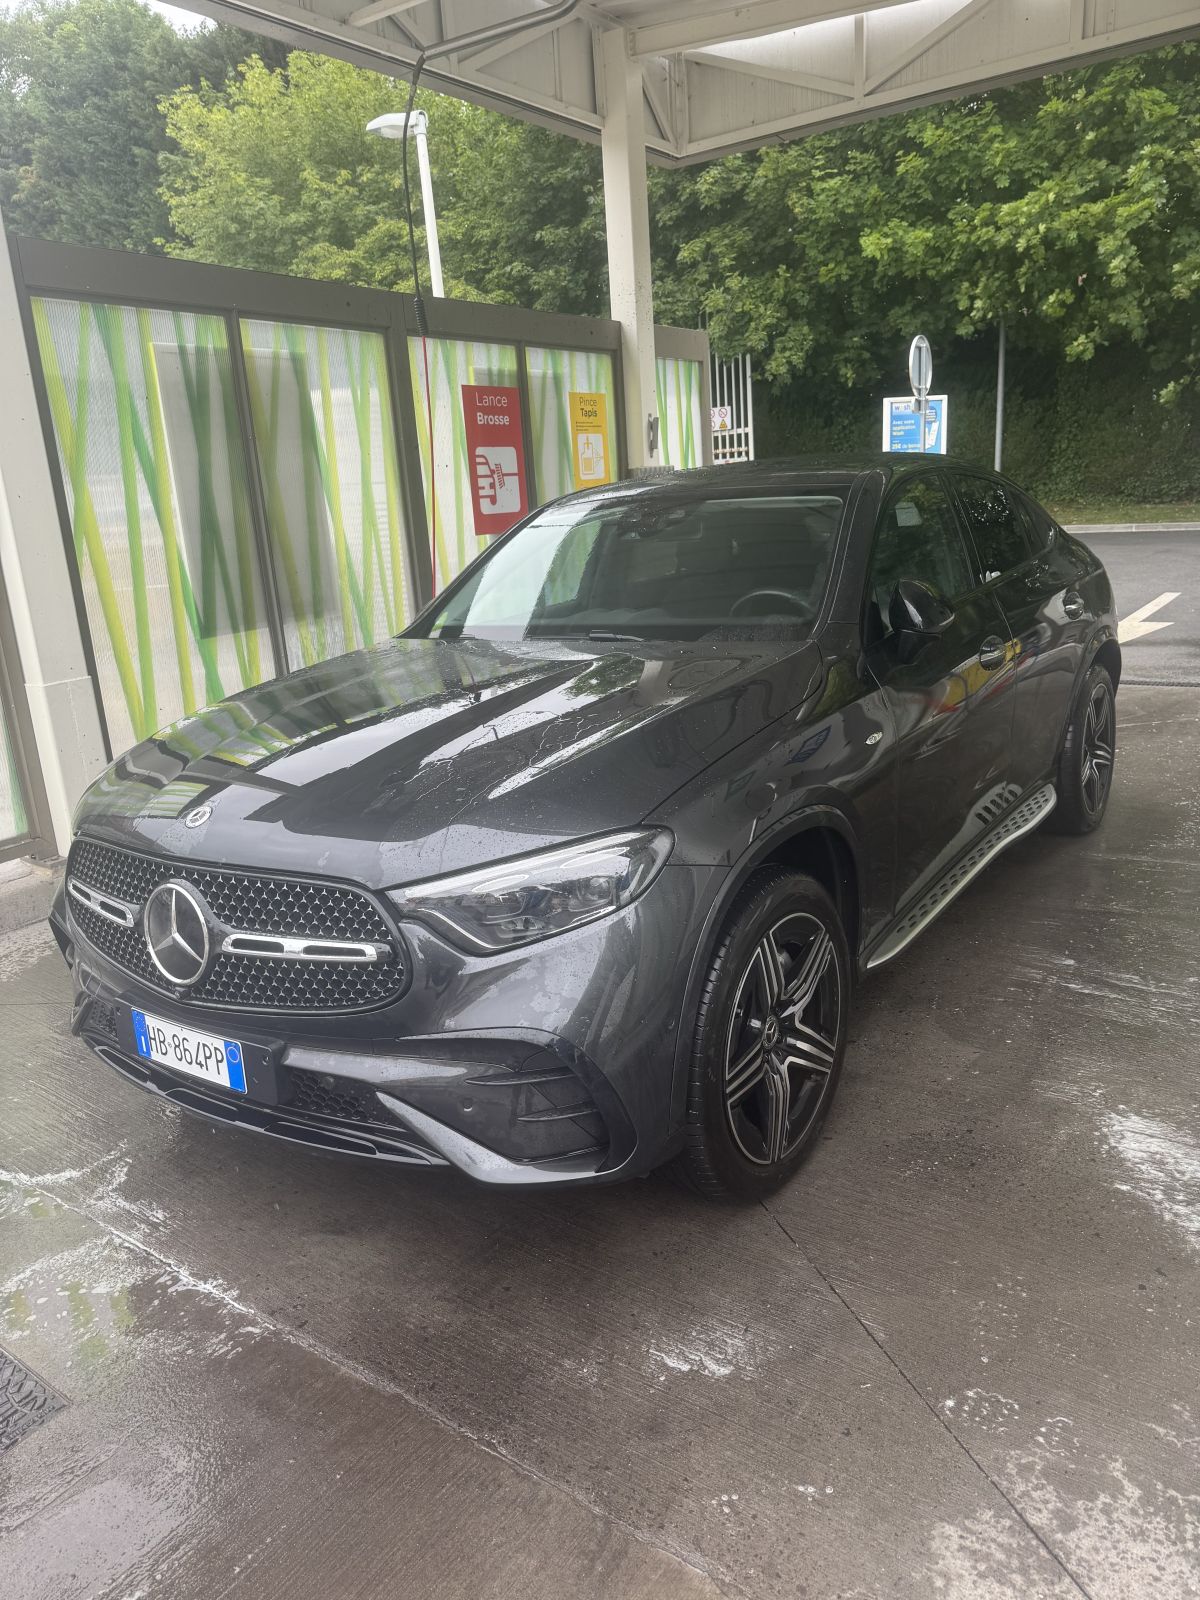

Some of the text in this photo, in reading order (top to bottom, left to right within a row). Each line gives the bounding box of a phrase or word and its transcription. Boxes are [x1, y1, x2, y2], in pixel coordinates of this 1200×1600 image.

[475, 392, 508, 407] Lance
[579, 396, 598, 407] Pince
[476, 412, 510, 426] Brosse
[580, 408, 598, 419] Tapis
